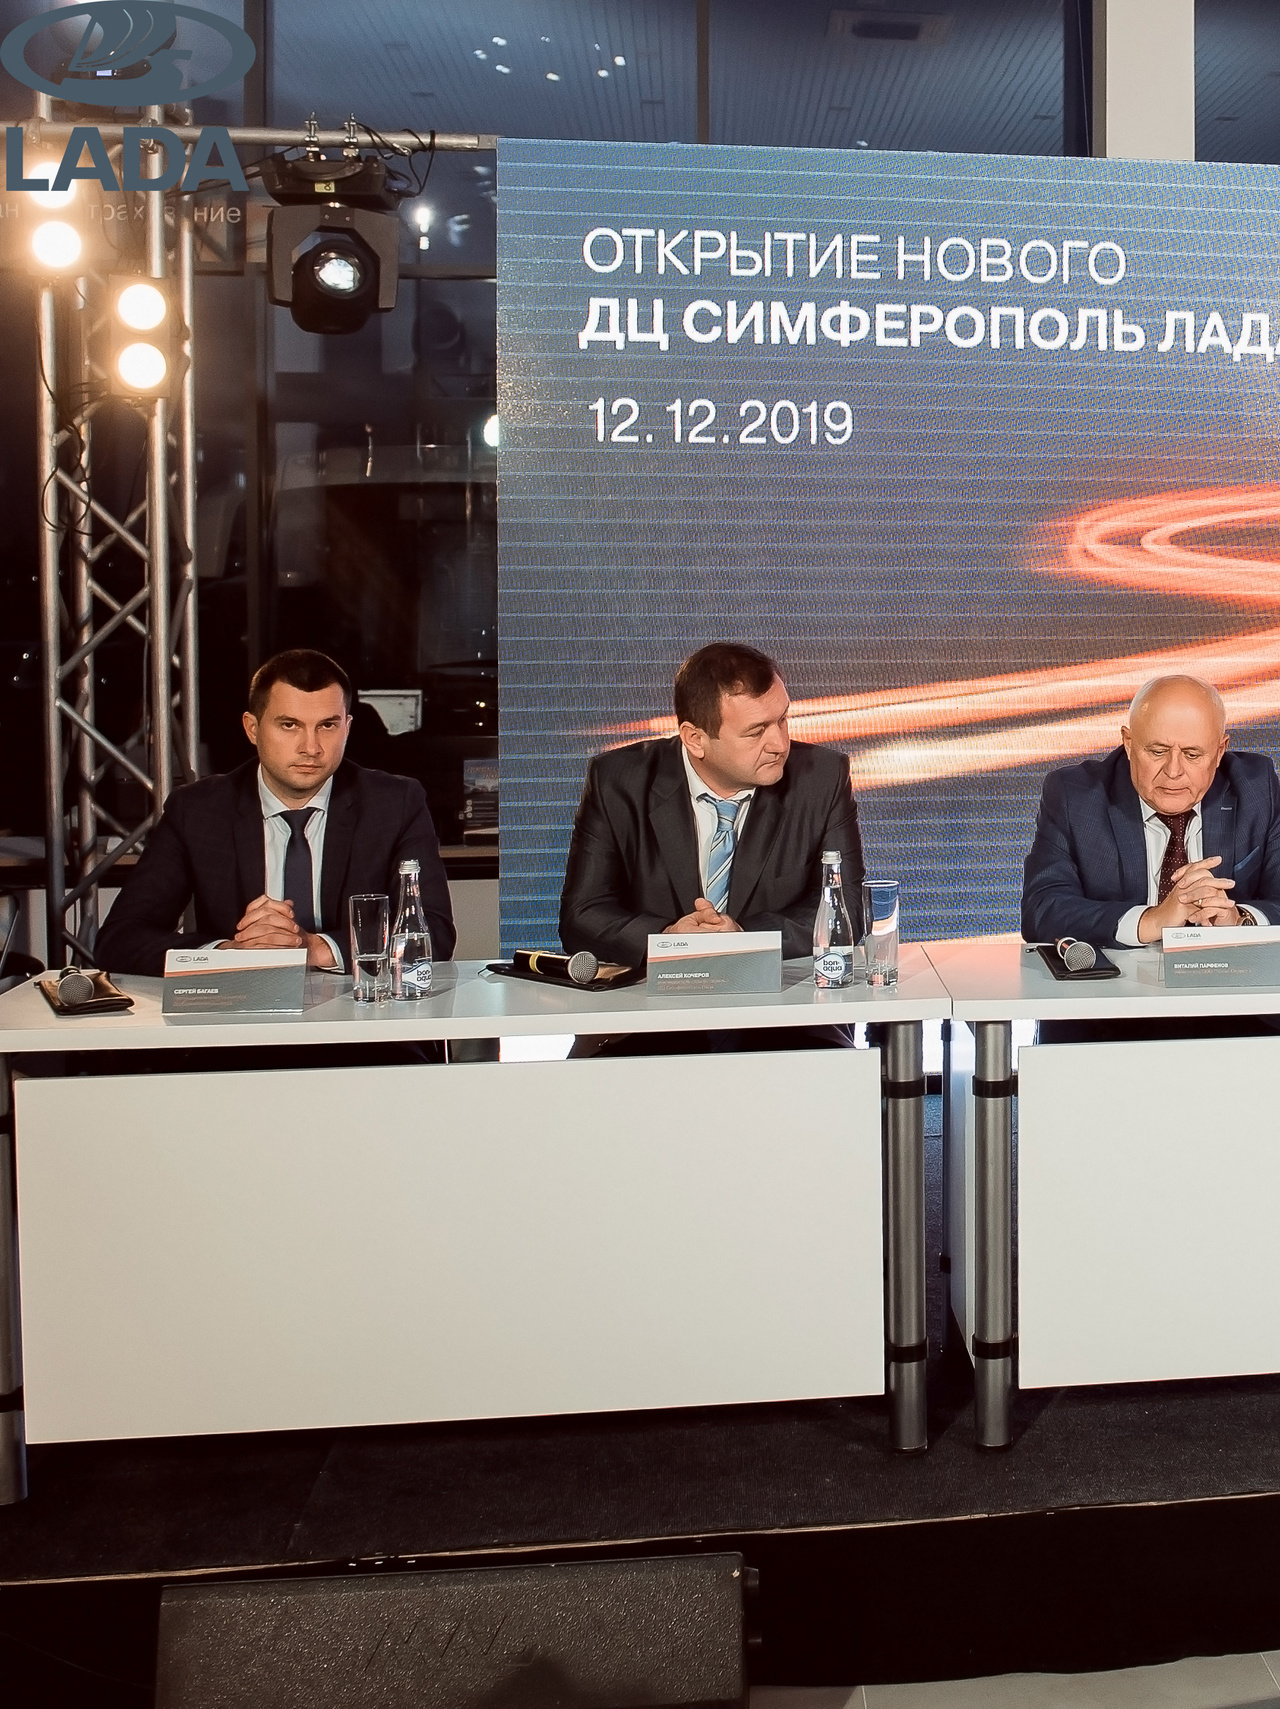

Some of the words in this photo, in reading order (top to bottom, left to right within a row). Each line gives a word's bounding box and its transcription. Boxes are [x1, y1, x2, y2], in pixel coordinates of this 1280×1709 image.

[582, 227, 881, 280] ОТКРЫТИЕ
[897, 236, 1127, 286] НОВОГО
[578, 297, 670, 351] ДЦ
[682, 298, 1147, 354] СИМФЕРОПОЛЬ
